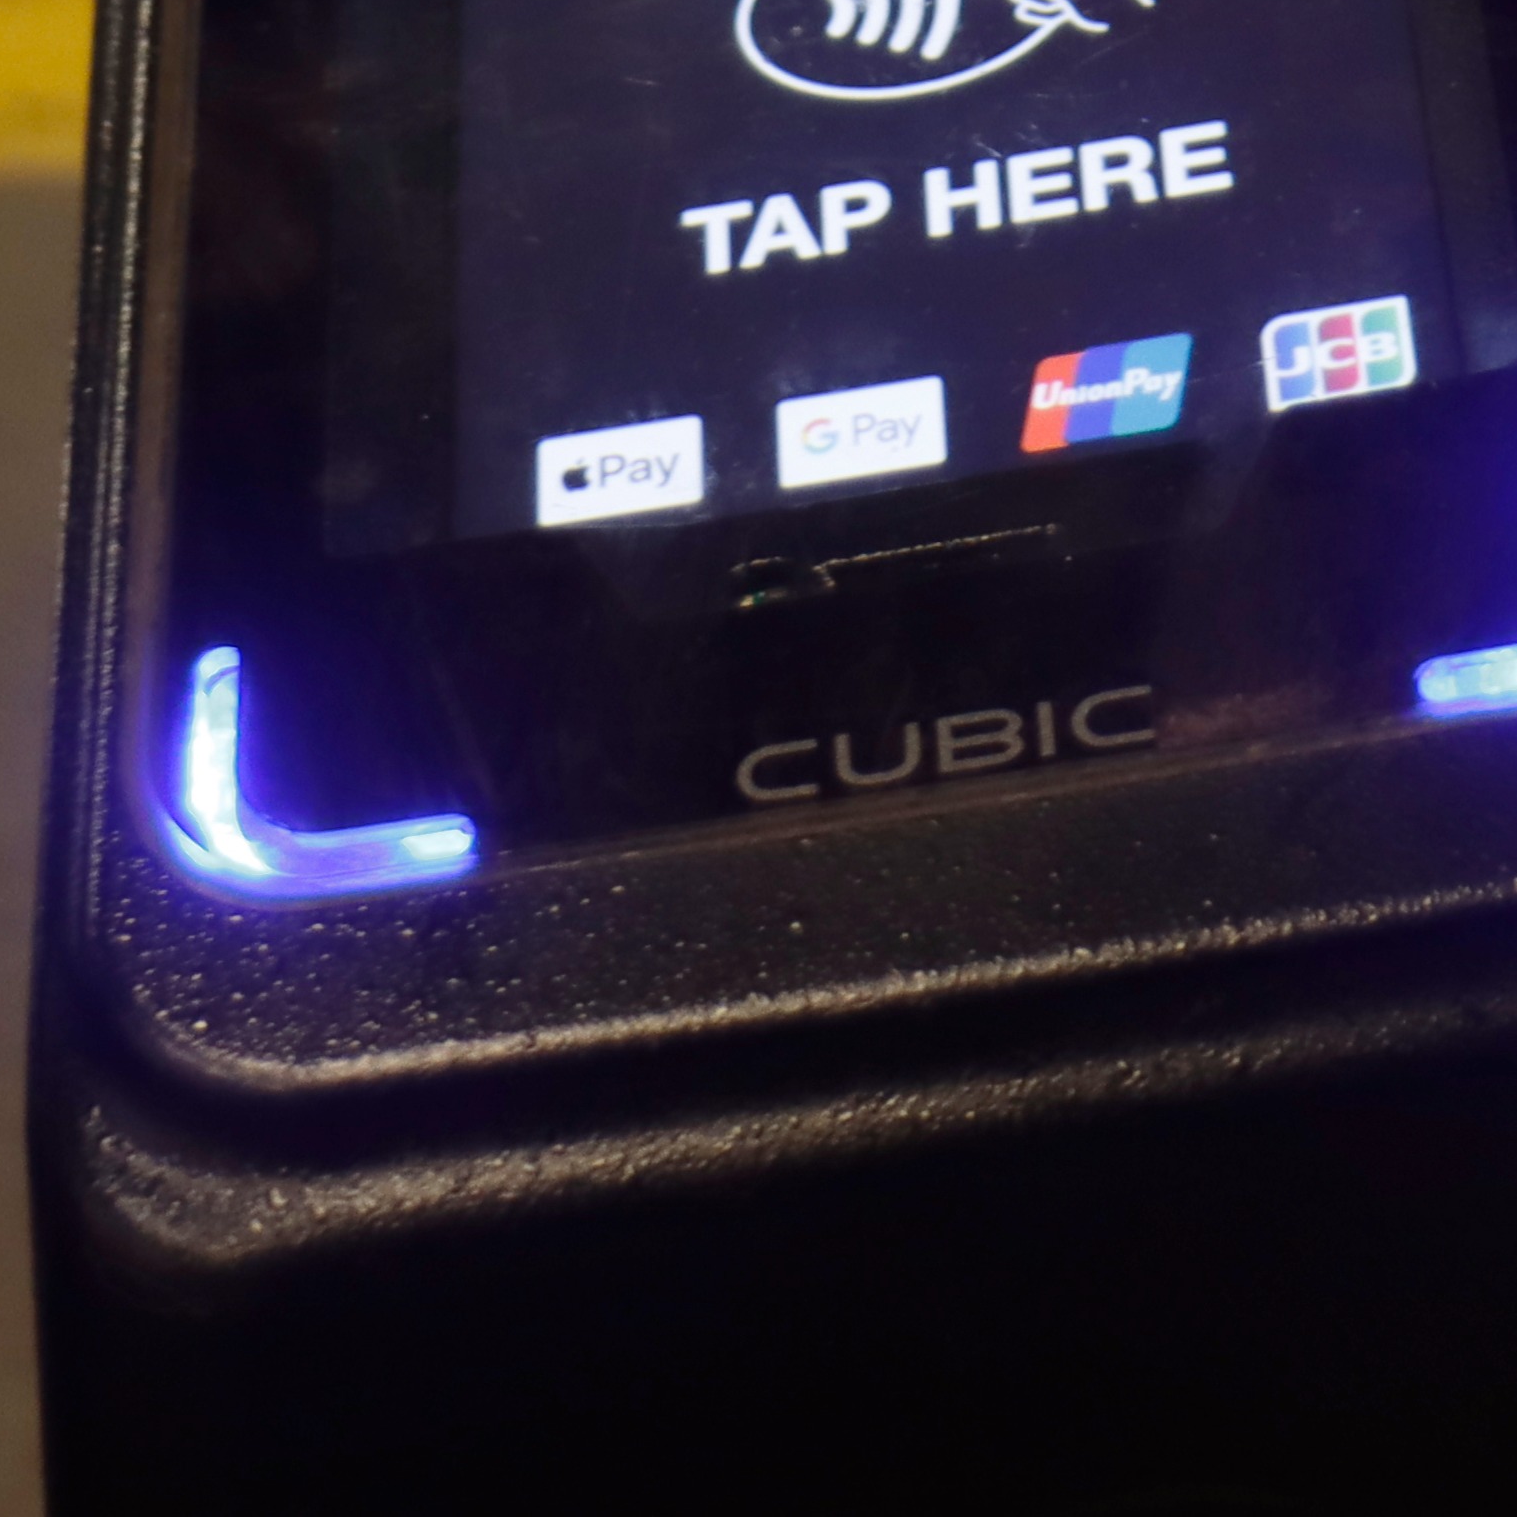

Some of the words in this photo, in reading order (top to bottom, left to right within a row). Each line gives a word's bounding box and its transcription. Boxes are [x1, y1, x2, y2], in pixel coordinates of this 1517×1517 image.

[679, 179, 893, 276] TAP
[923, 119, 1236, 240] HERE
[1272, 331, 1400, 379] JCB
[1030, 366, 1184, 410] UnionPay
[851, 412, 924, 448] Pay
[597, 452, 682, 488] Pay
[736, 683, 1157, 802] CUBIC
